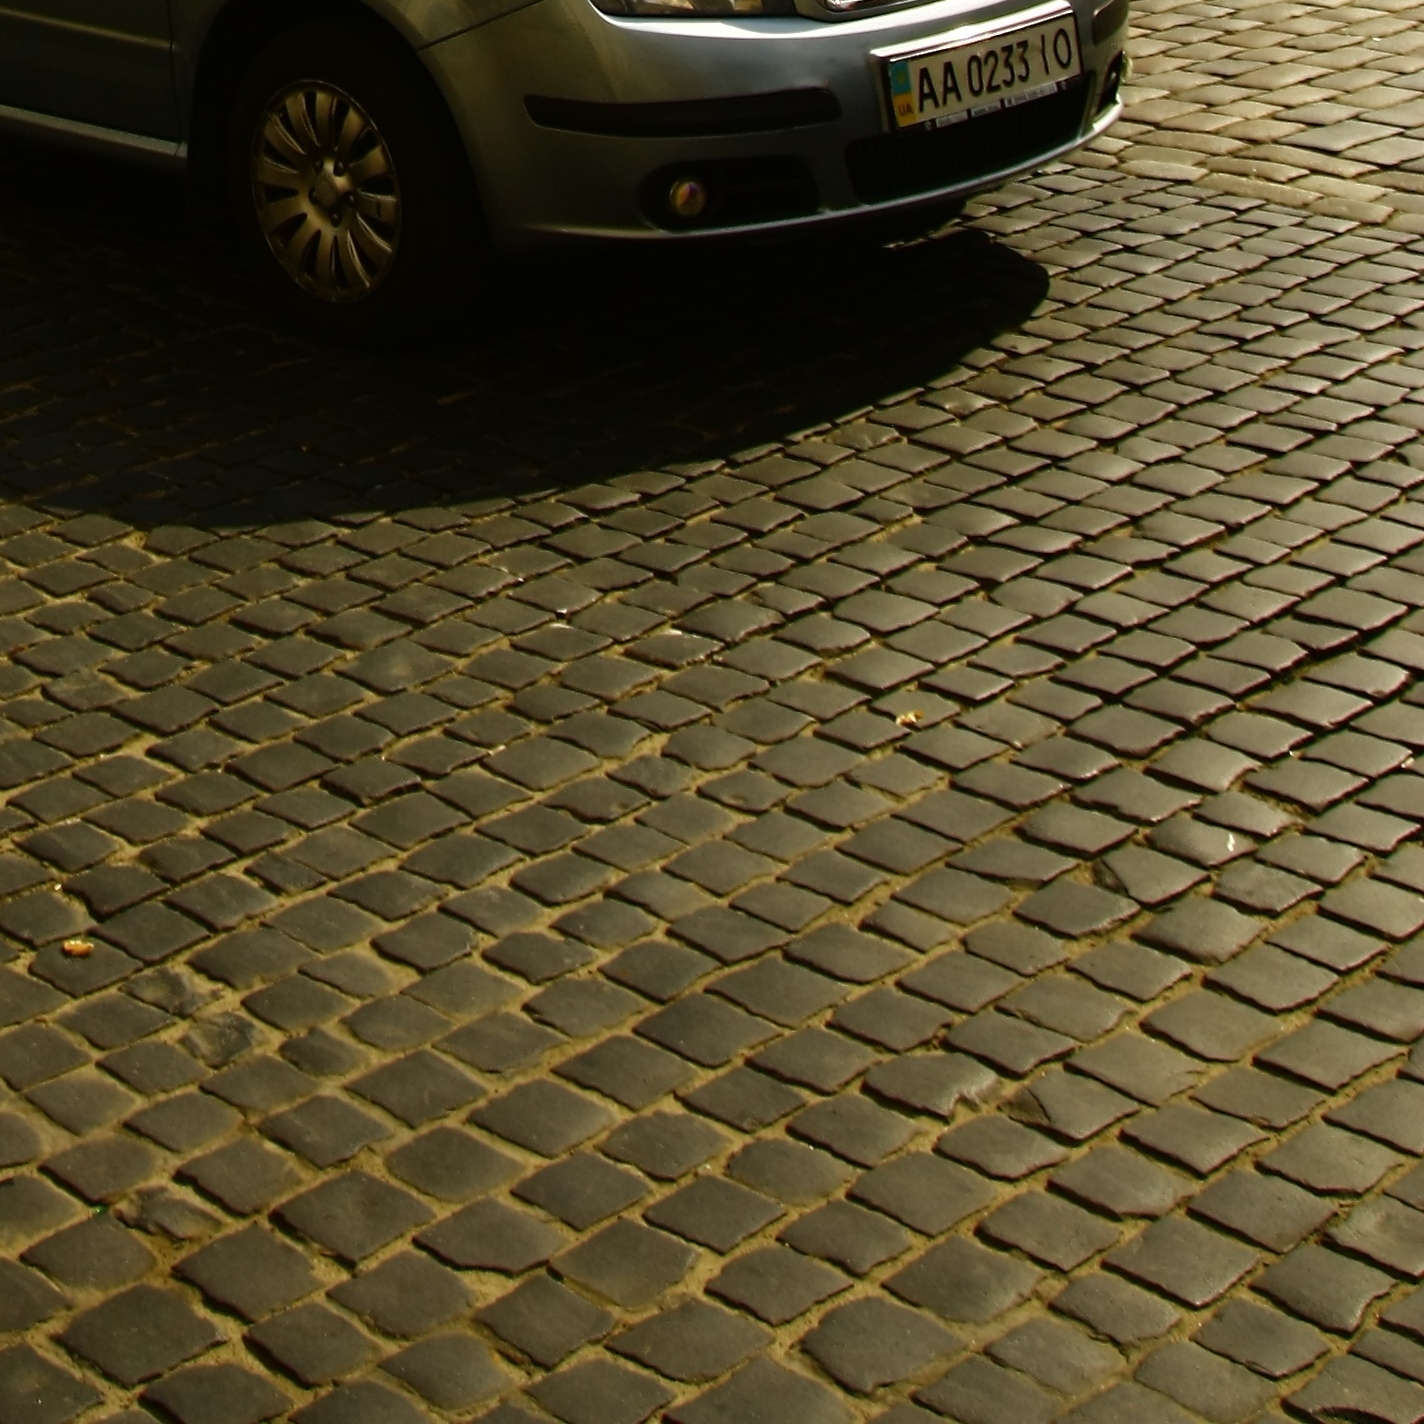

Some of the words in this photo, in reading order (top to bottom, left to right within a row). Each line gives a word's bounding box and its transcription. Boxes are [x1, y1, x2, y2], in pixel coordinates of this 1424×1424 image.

[898, 102, 914, 117] UA
[918, 61, 963, 113] AA
[967, 40, 1030, 97] 0233
[1040, 28, 1072, 76] IO
